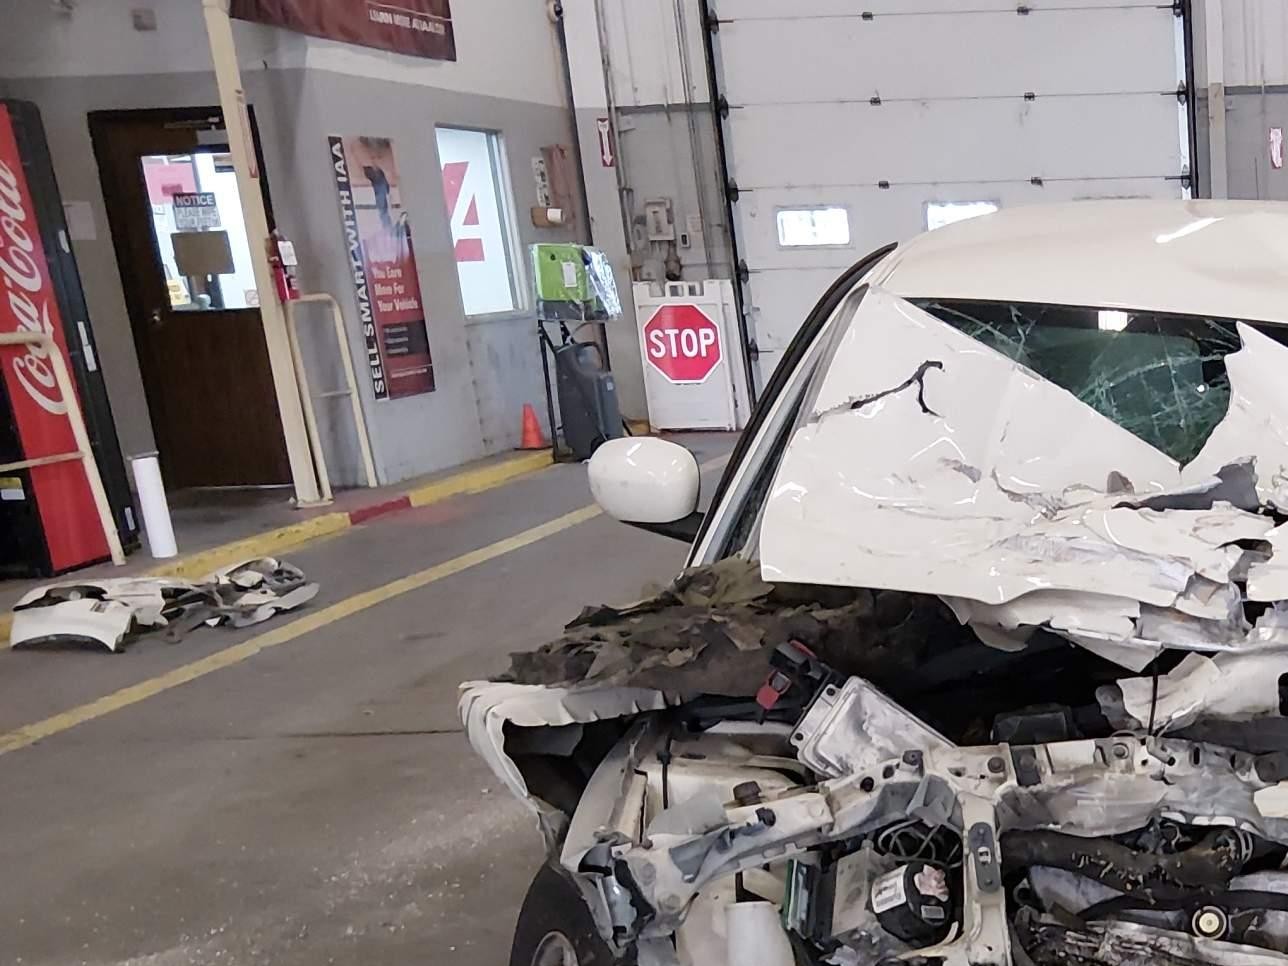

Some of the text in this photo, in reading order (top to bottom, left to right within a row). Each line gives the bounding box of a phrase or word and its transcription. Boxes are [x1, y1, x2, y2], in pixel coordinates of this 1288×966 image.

[176, 194, 214, 206] NOTICE
[331, 142, 385, 394] SELL SMART WITH IAA
[650, 328, 715, 358] STOP
